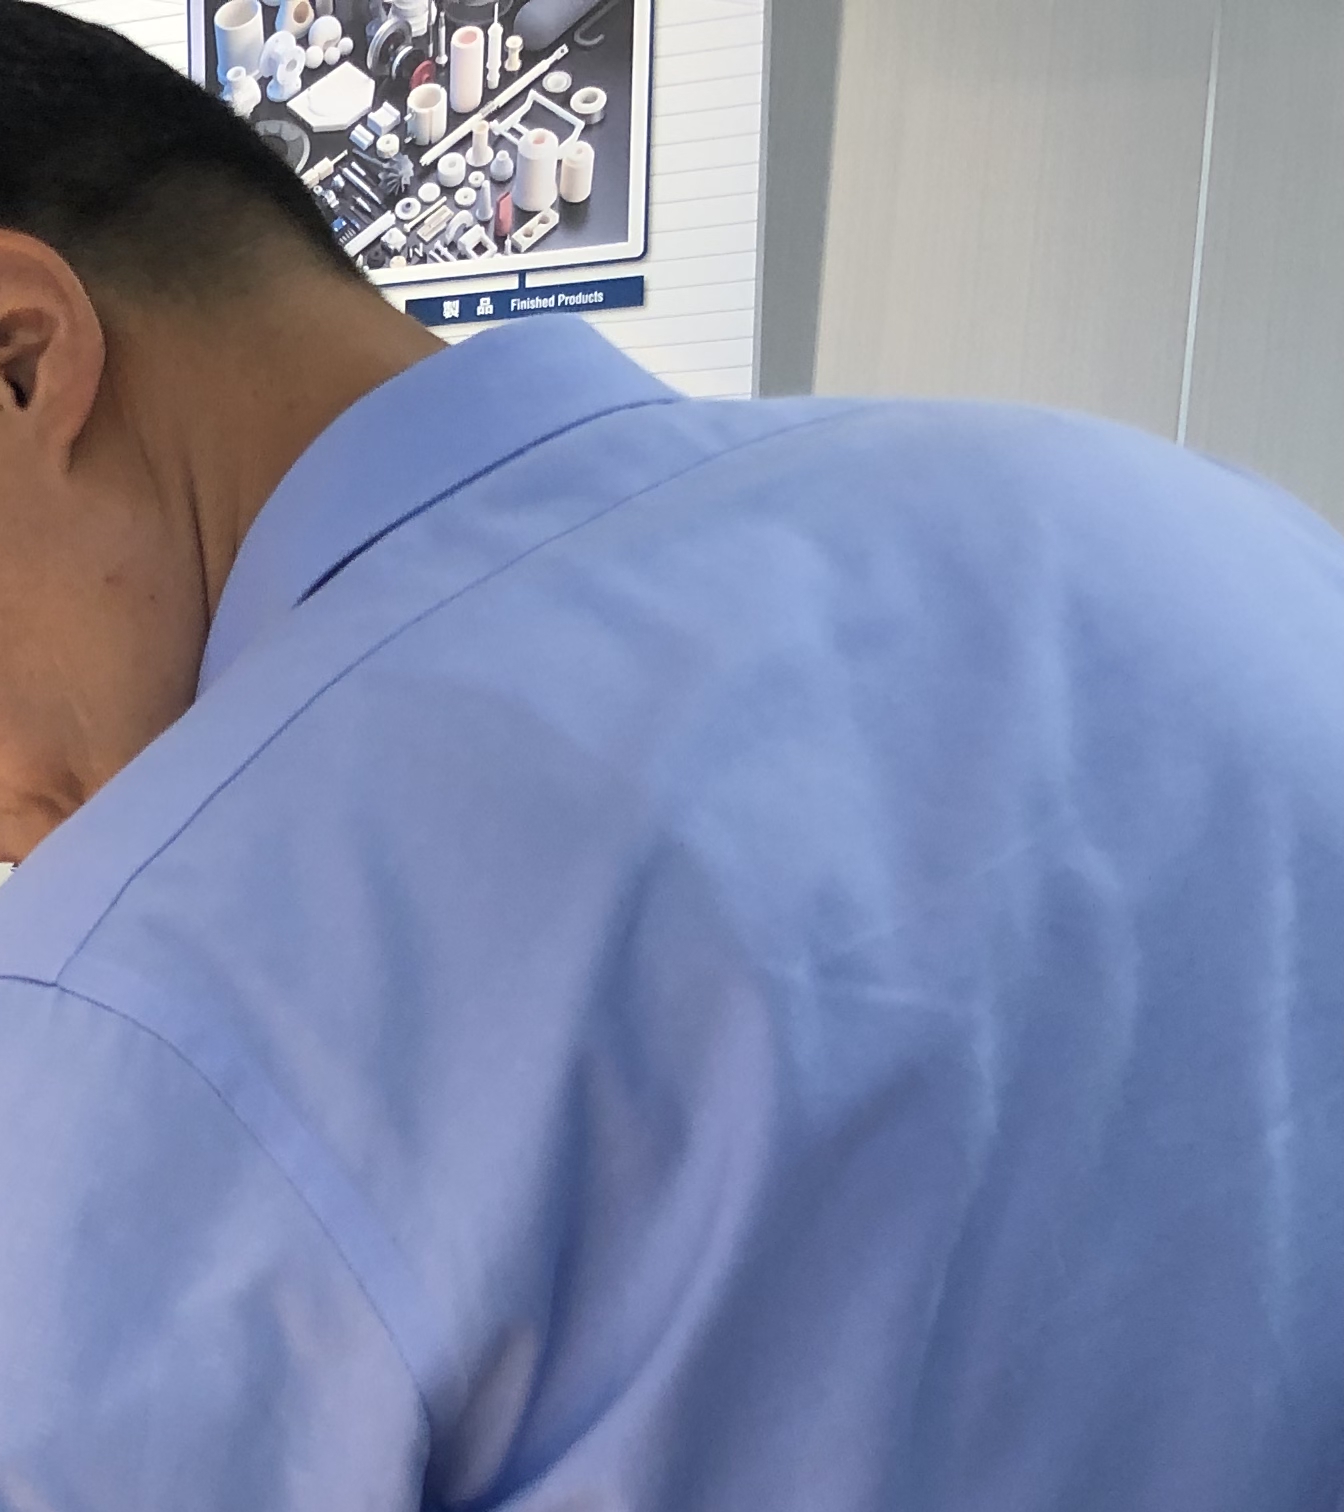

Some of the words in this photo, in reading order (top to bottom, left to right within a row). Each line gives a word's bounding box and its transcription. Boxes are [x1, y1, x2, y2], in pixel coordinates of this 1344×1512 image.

[442, 296, 494, 319] 製品
[510, 297, 555, 312] Finished
[557, 291, 604, 307] Products
